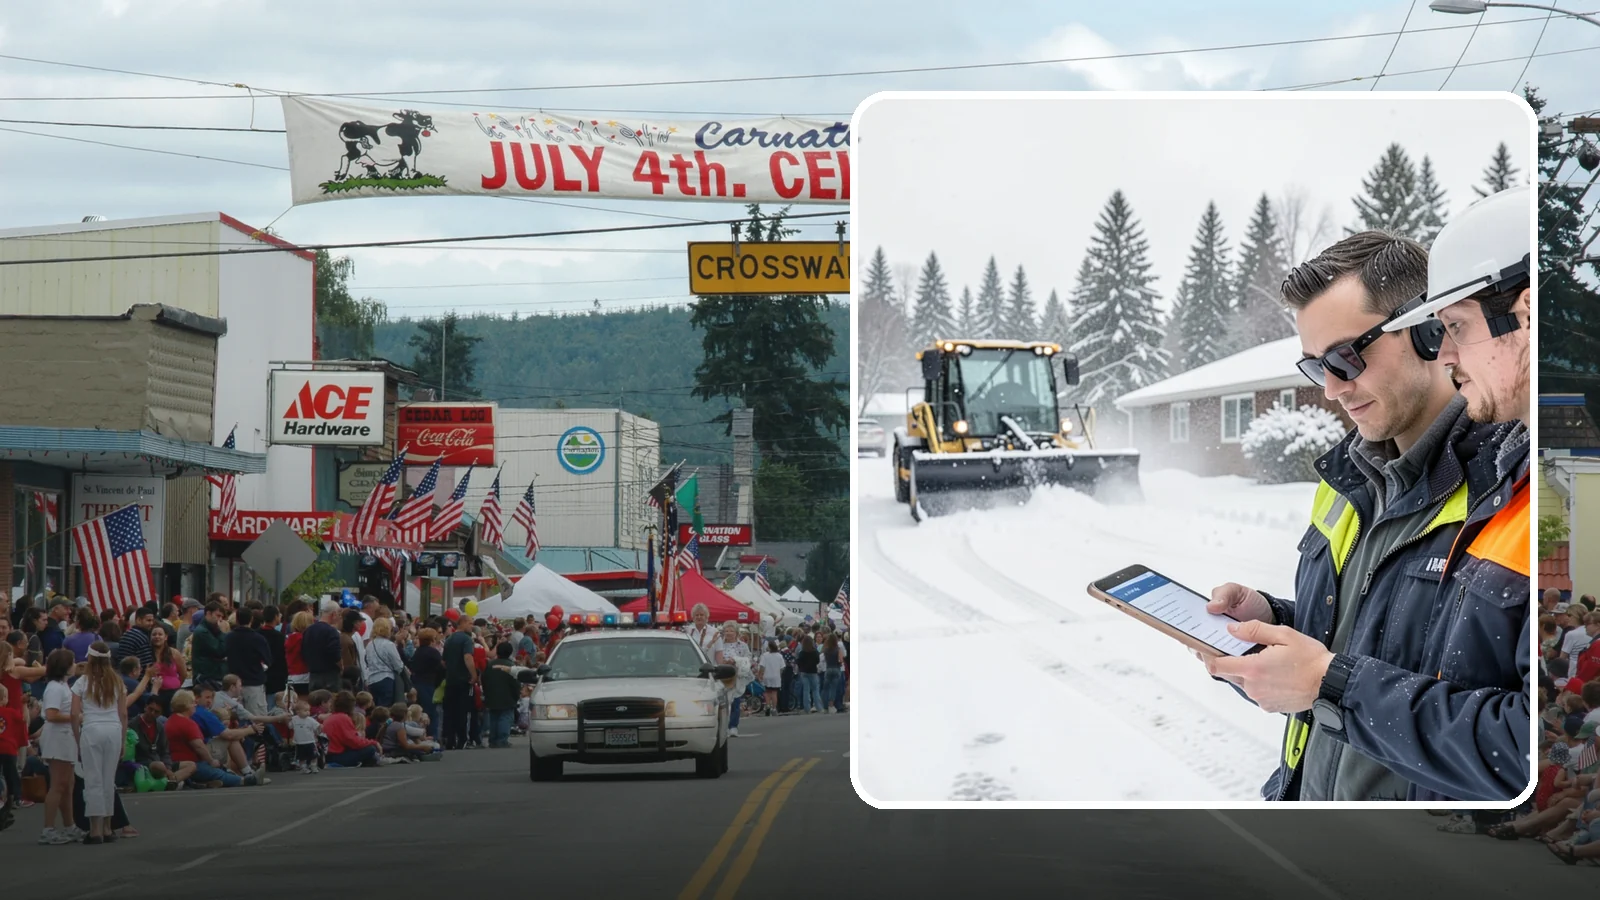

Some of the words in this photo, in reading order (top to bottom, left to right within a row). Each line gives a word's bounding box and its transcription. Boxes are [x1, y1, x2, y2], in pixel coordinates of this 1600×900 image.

[481, 141, 604, 192] JULY
[632, 150, 746, 198] 4th.
[697, 254, 850, 280] CROSSWA
[283, 380, 373, 420] ACE
[405, 409, 452, 422] CEDAR
[283, 421, 371, 436] Hardware
[354, 467, 387, 480] Simpl
[83, 485, 93, 494] St.
[96, 485, 124, 494] Vincent
[126, 486, 135, 494] de
[137, 486, 155, 495] Paul
[688, 526, 741, 535] CRNATION
[699, 535, 730, 543] GLASS
